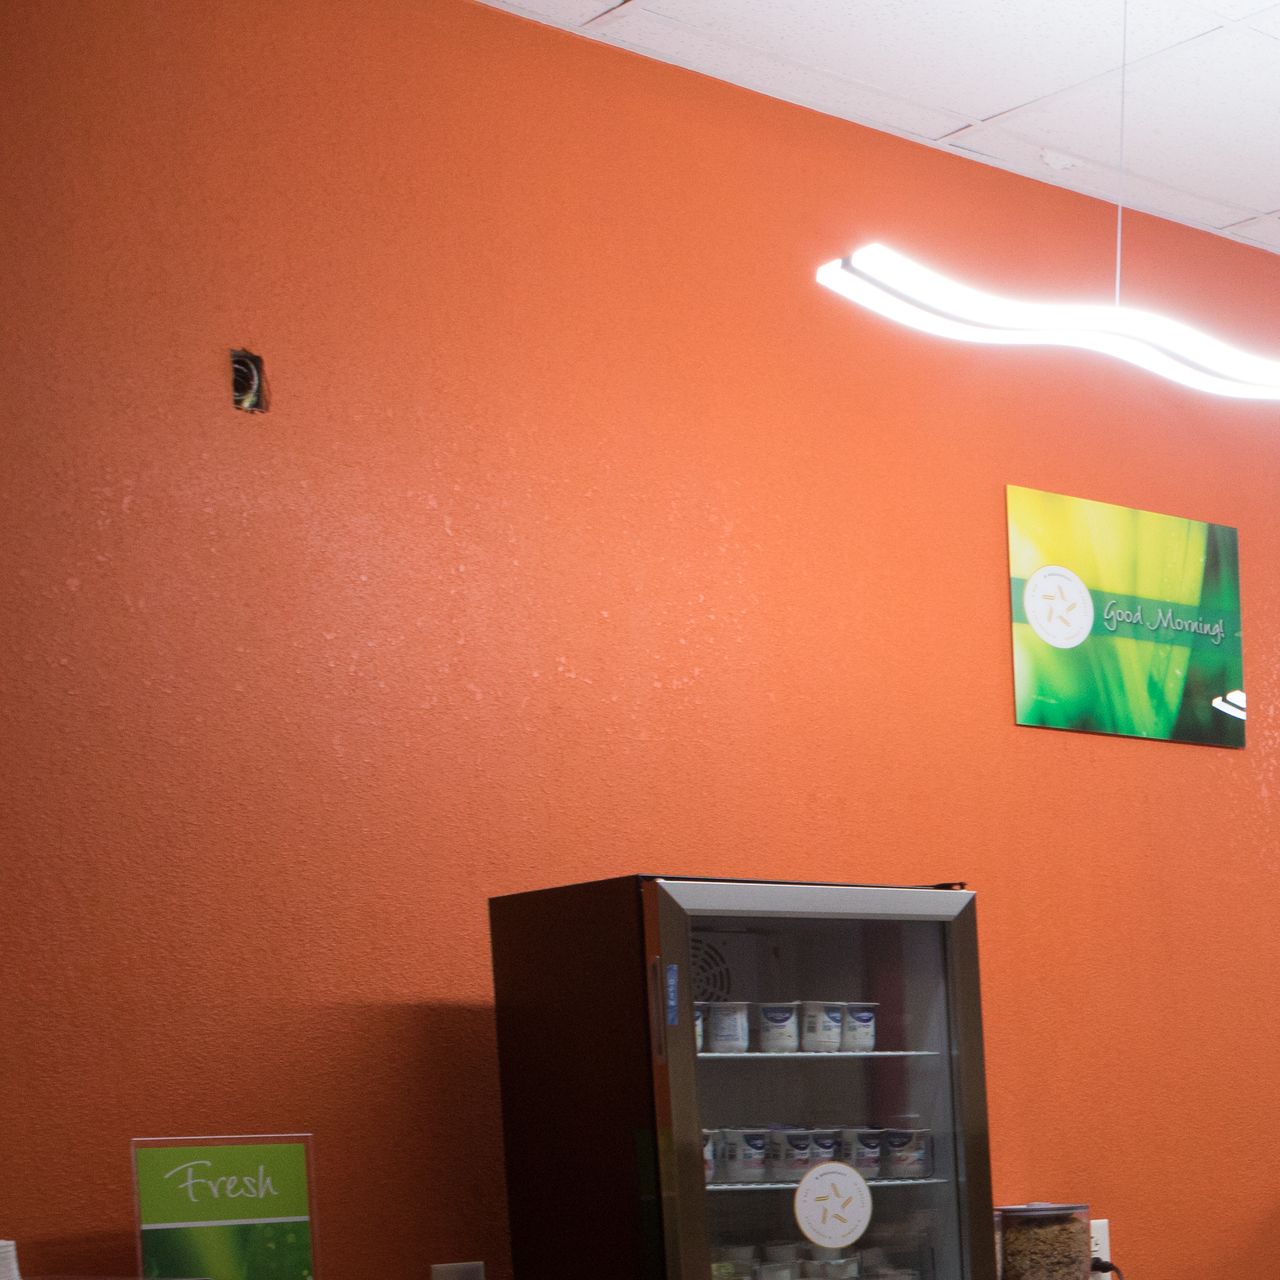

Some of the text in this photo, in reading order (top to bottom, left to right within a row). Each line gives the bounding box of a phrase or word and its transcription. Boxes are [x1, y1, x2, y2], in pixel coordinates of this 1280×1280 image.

[1103, 599, 1225, 645] Good Morning!
[164, 1160, 279, 1203] Fresh
